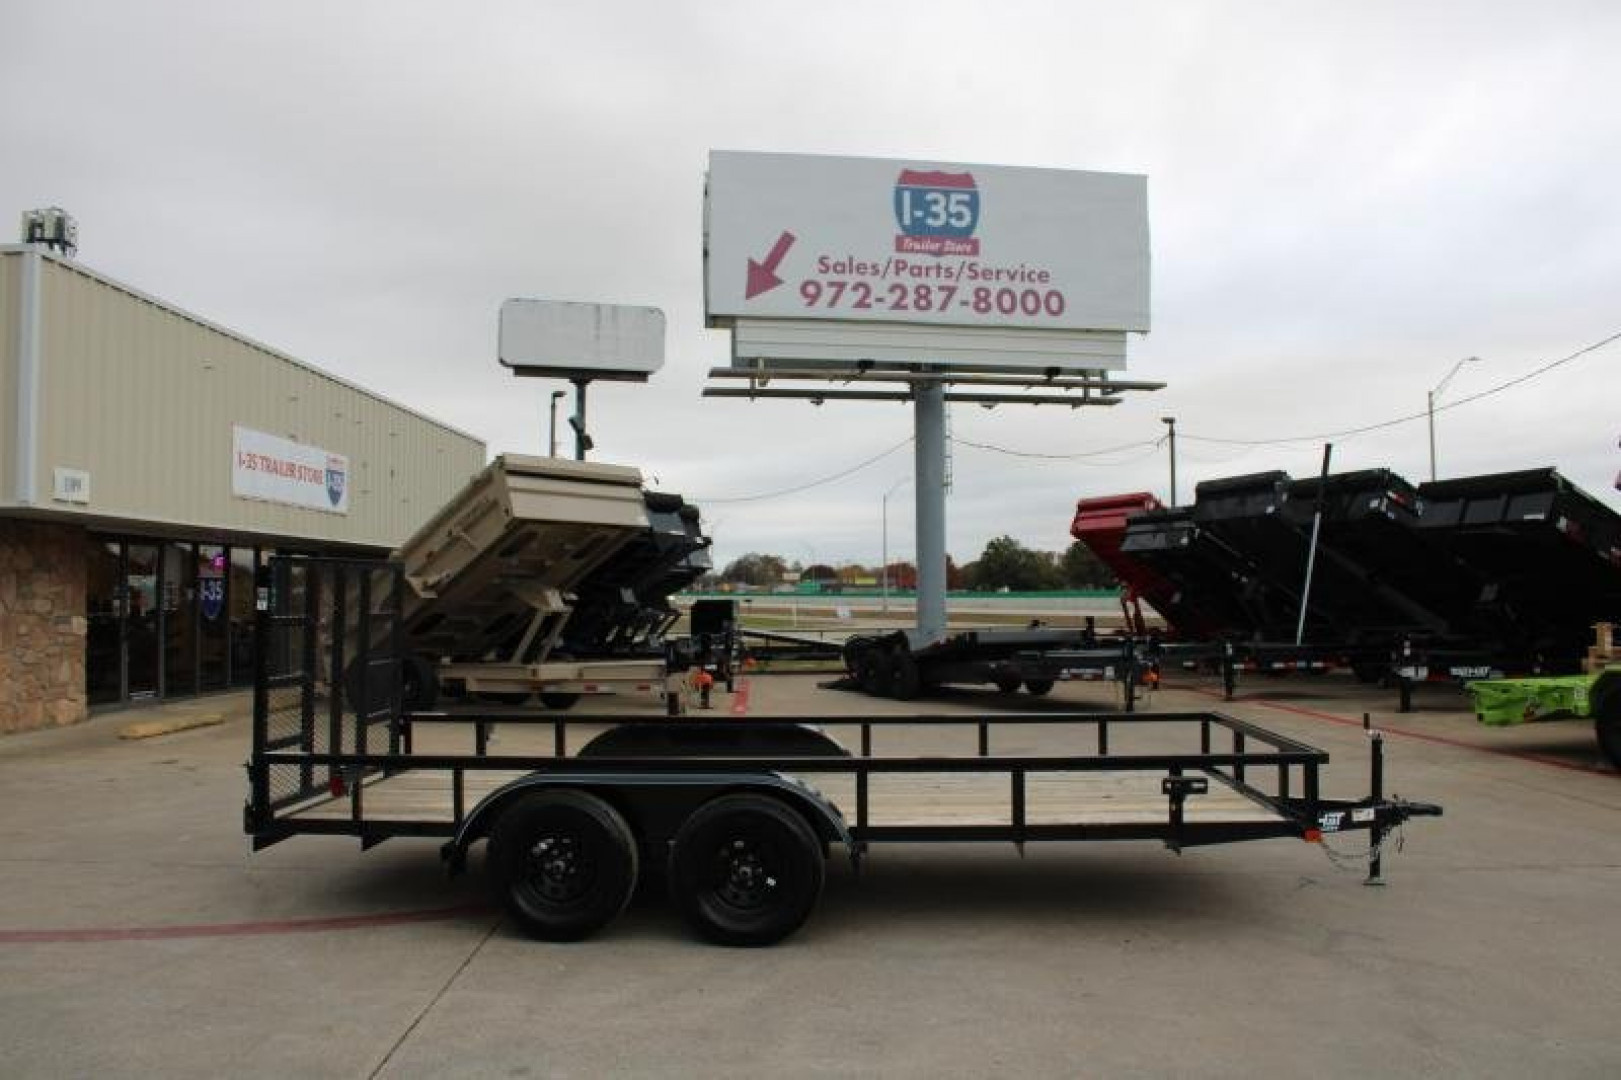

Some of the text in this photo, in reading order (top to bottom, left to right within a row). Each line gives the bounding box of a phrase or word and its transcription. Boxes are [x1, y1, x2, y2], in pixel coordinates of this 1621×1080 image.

[903, 190, 971, 227] I-35
[903, 238, 972, 252] Trailer Store
[817, 255, 1051, 283] Sales/Parts/Service
[800, 279, 1065, 317] 972-287-8000
[238, 451, 324, 486] I-35 TRAILER STORE
[200, 581, 223, 600] I-35
